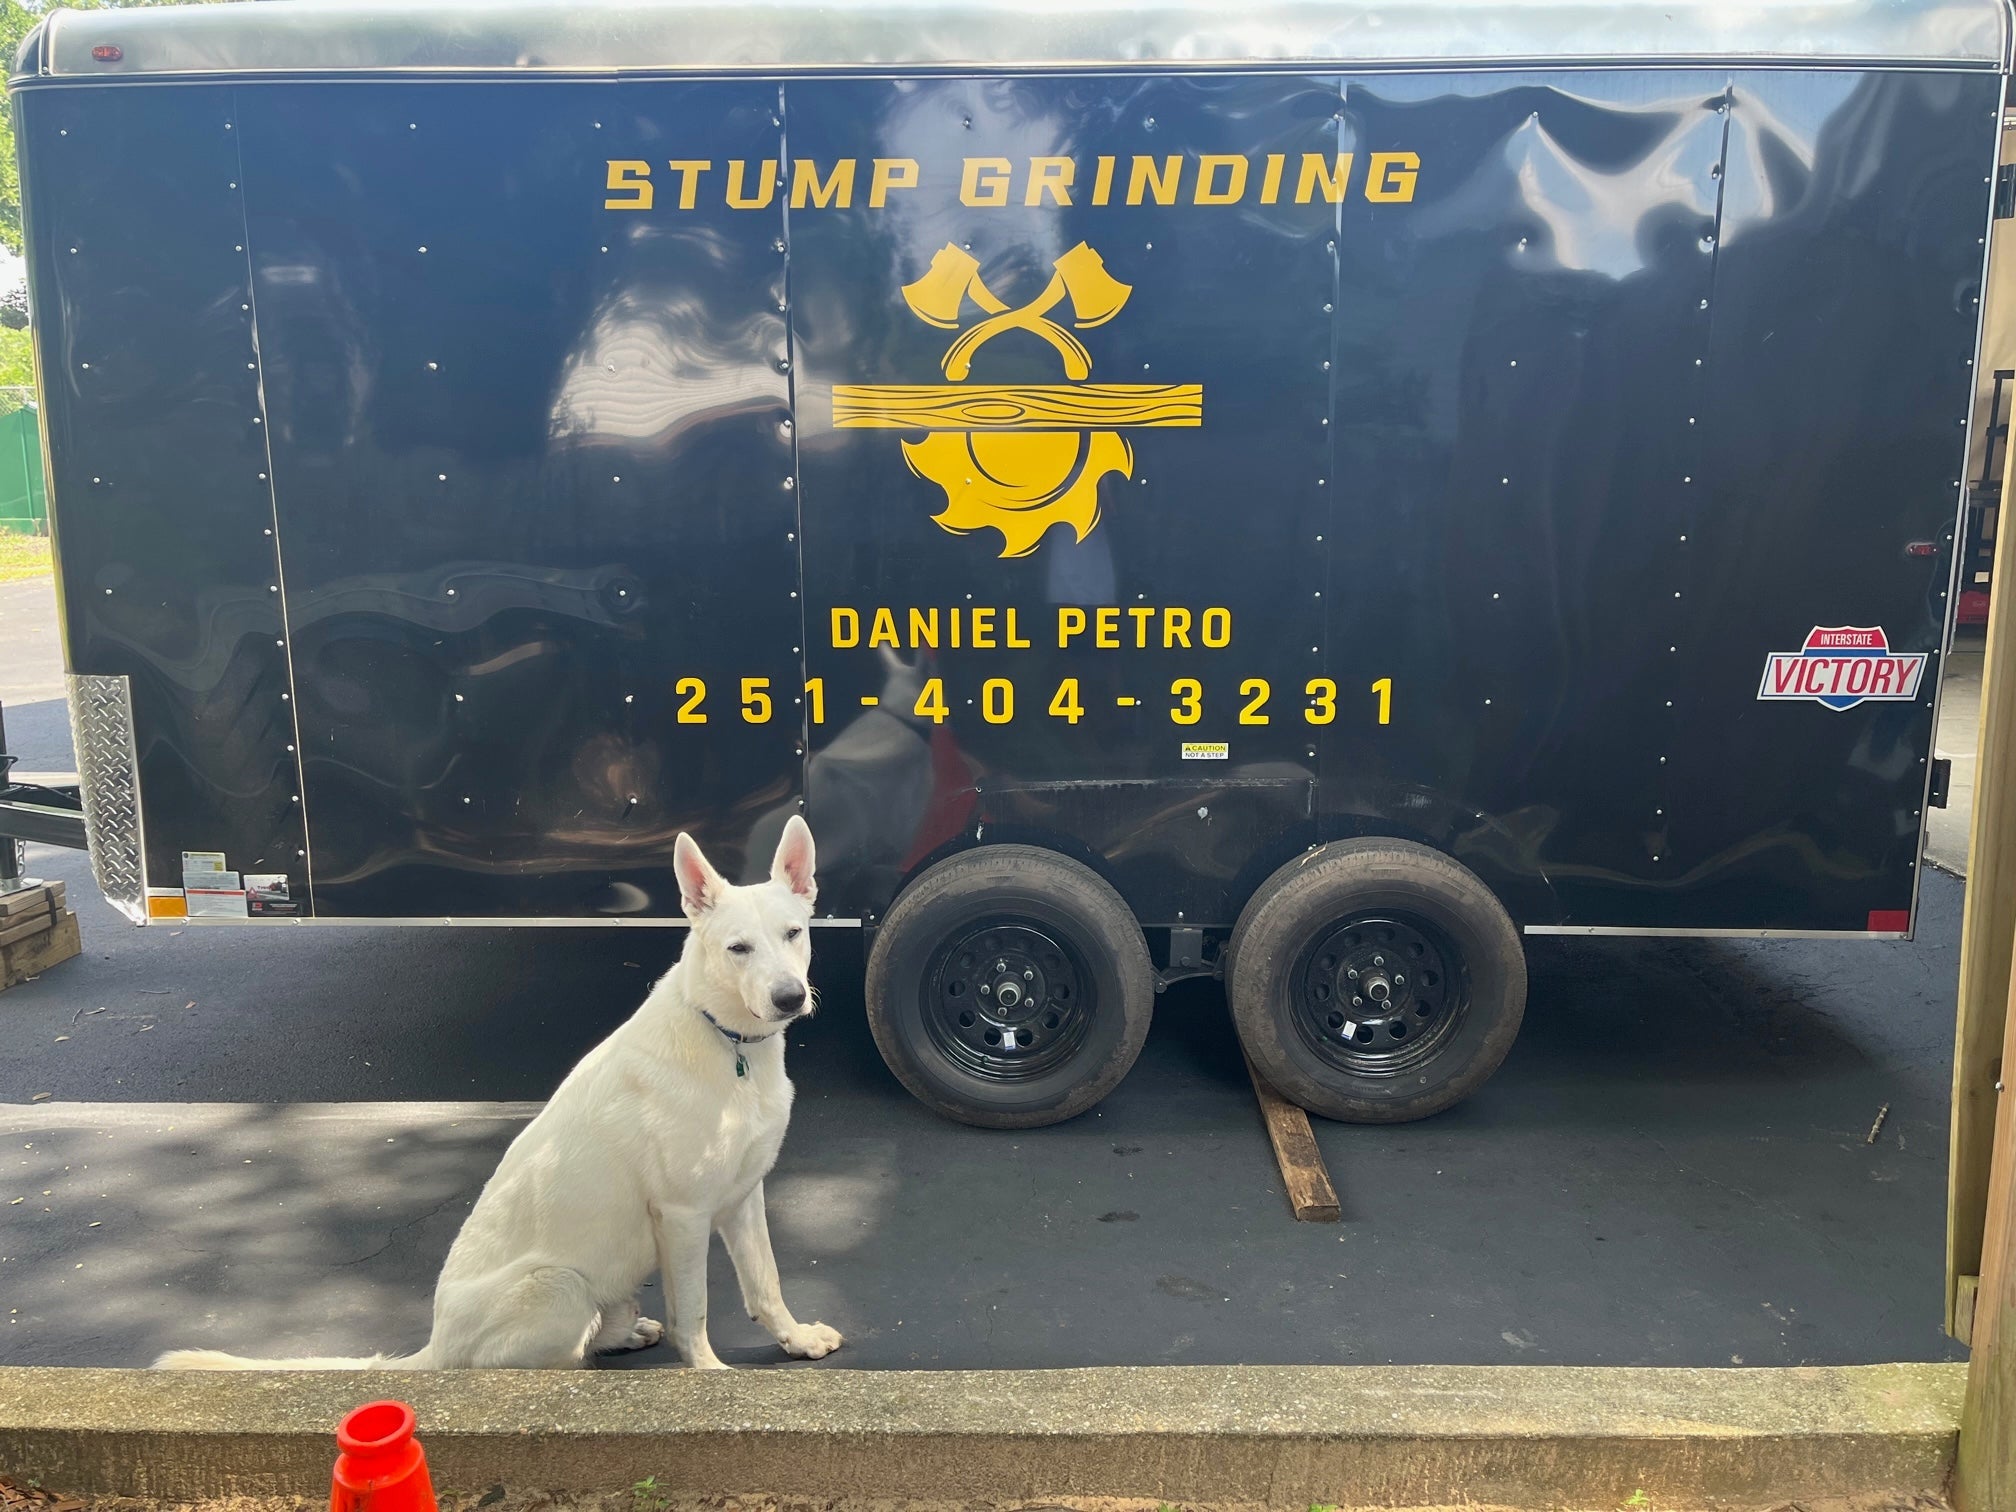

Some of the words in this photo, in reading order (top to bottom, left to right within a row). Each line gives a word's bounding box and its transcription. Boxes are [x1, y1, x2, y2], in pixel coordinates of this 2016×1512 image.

[603, 158, 921, 210] STUMP
[958, 151, 1421, 206] GRINDING
[830, 606, 1032, 650] DANIEL
[1056, 606, 1234, 650] PETRO
[1820, 633, 1873, 646] INTERSTATE
[1774, 658, 1920, 695] VICTORY
